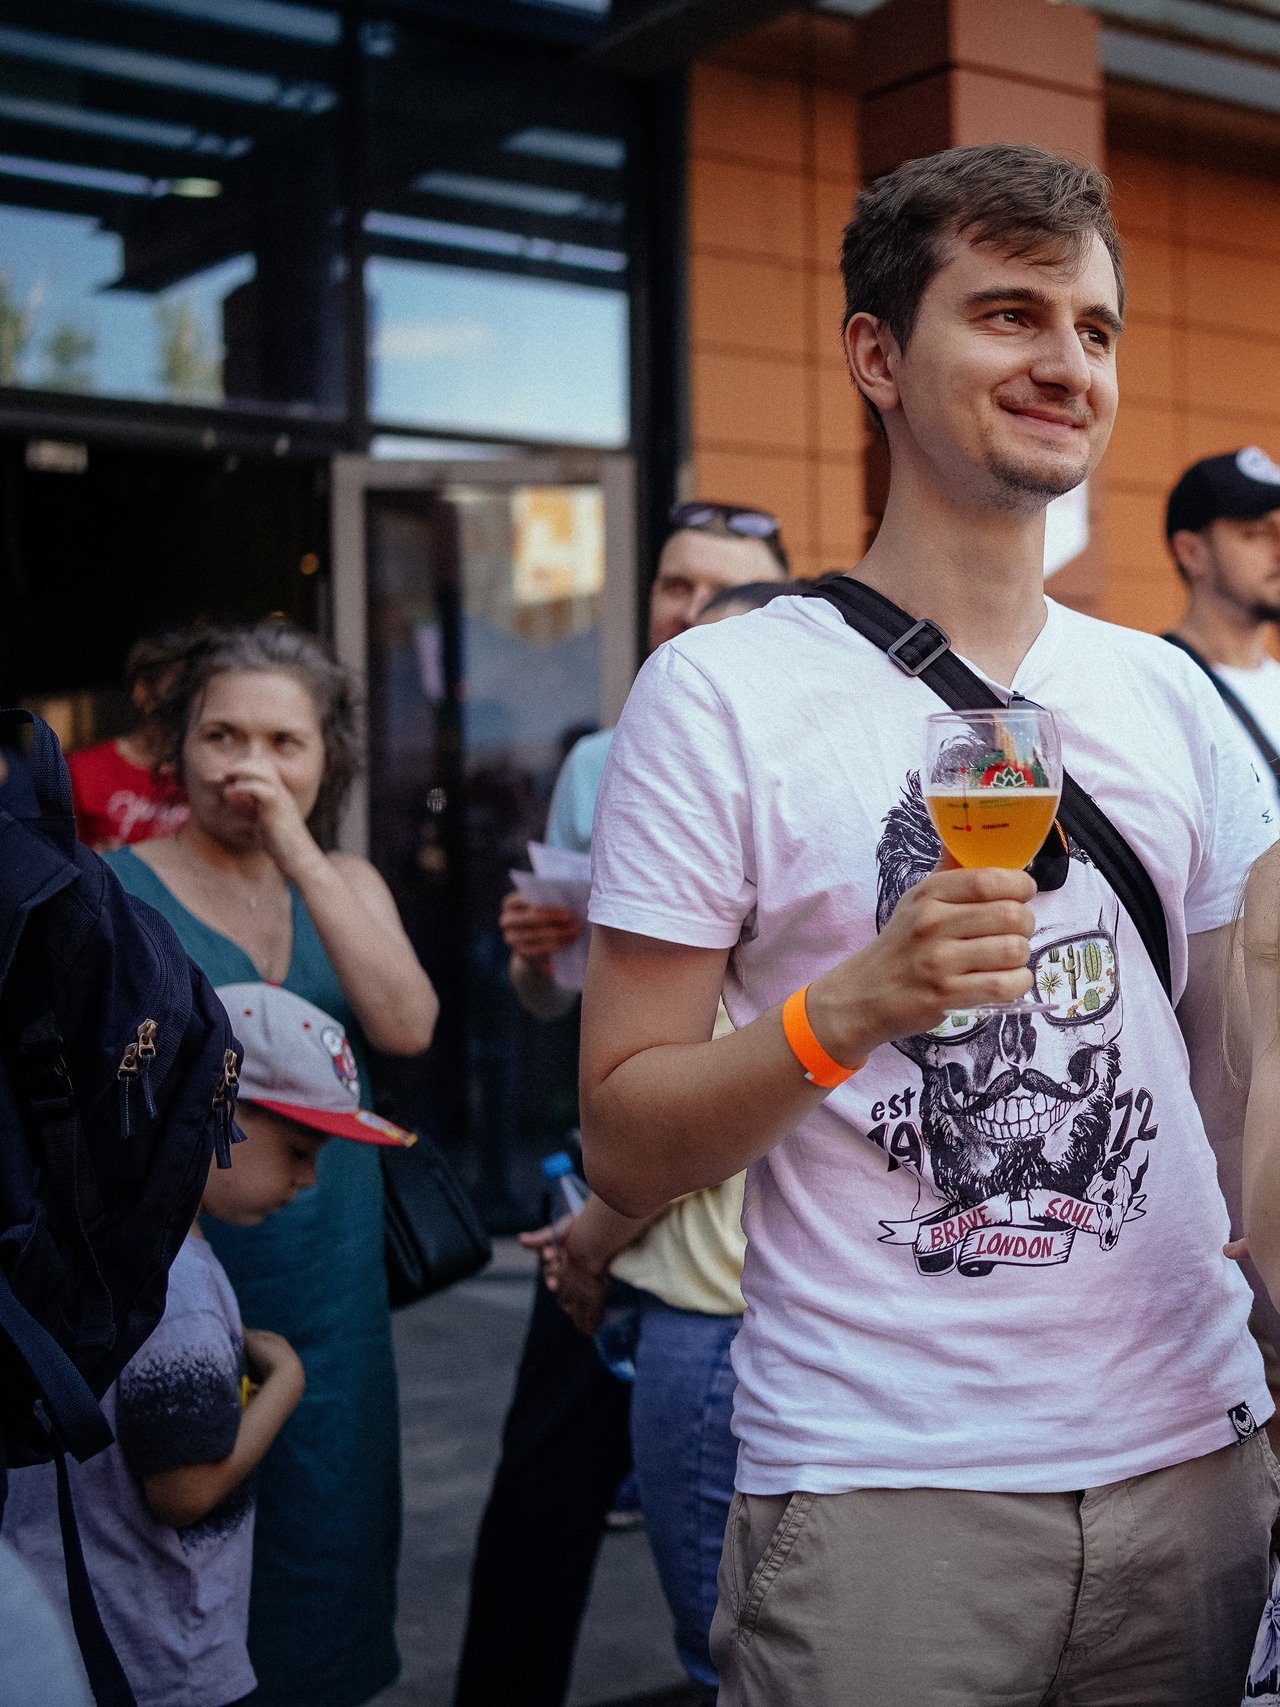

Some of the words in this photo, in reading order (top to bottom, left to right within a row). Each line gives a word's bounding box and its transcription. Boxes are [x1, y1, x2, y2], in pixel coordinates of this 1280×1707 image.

[871, 1086, 916, 1122] est
[1110, 1087, 1158, 1152] 72
[930, 1204, 993, 1248] BRAVE
[1044, 1198, 1095, 1229] SOUL
[975, 1233, 1055, 1259] LONDON
